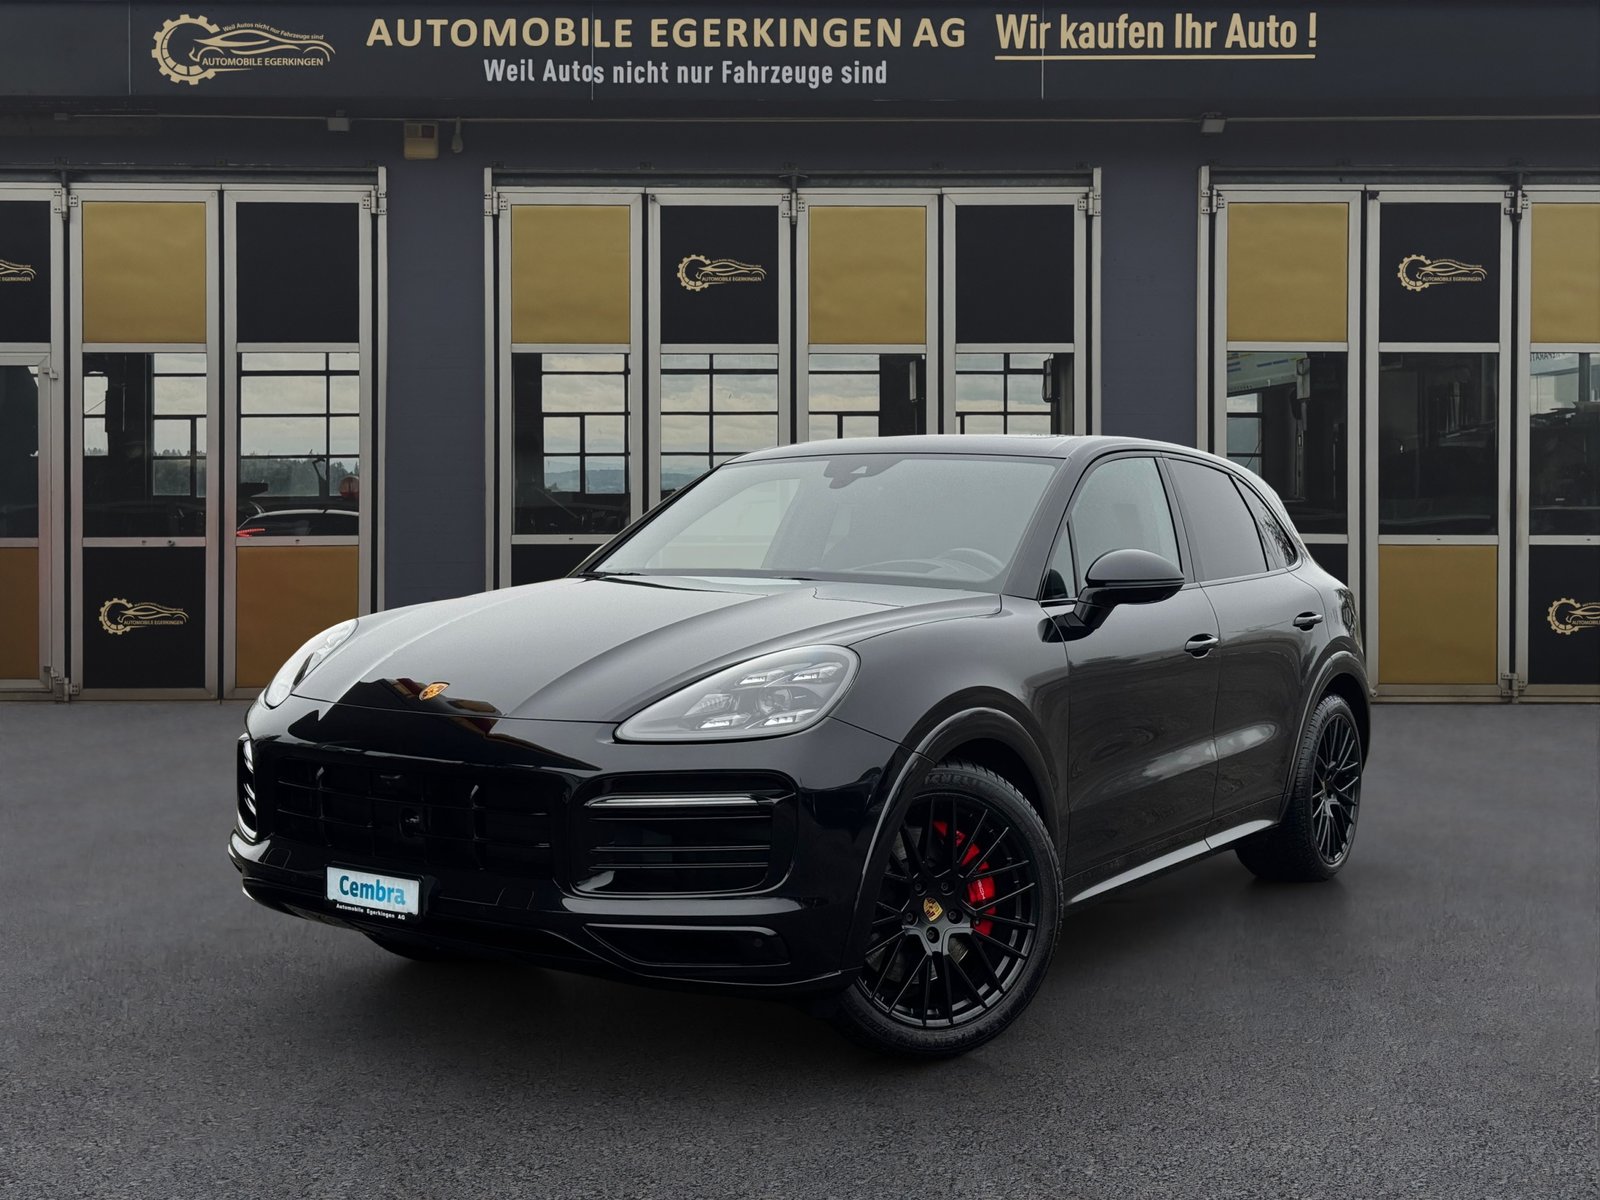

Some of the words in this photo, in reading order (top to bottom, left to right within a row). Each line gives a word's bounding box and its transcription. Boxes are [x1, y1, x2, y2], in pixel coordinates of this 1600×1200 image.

[255, 23, 270, 31] nicht
[280, 30, 310, 40] Fahrzeuge
[366, 17, 633, 48] AUTOMOBILE
[650, 17, 902, 48] EGERKINGEN
[912, 17, 966, 48] AG
[995, 14, 1051, 49] Wir
[1060, 13, 1164, 49] kaufen
[1175, 13, 1218, 49] Ihr
[1224, 13, 1298, 49] Auto
[202, 57, 263, 66] AUTOMOBILE
[264, 57, 324, 66] EGERKINGEN
[484, 59, 536, 82] Weil
[542, 59, 605, 84] Autos
[612, 60, 669, 84] nicht
[676, 65, 714, 84] nur
[721, 60, 833, 89] Fahrzeuge
[841, 60, 887, 84] sind
[339, 875, 406, 906] Cembra
[336, 903, 364, 913] Automobile
[366, 909, 395, 919] Egerkingen
